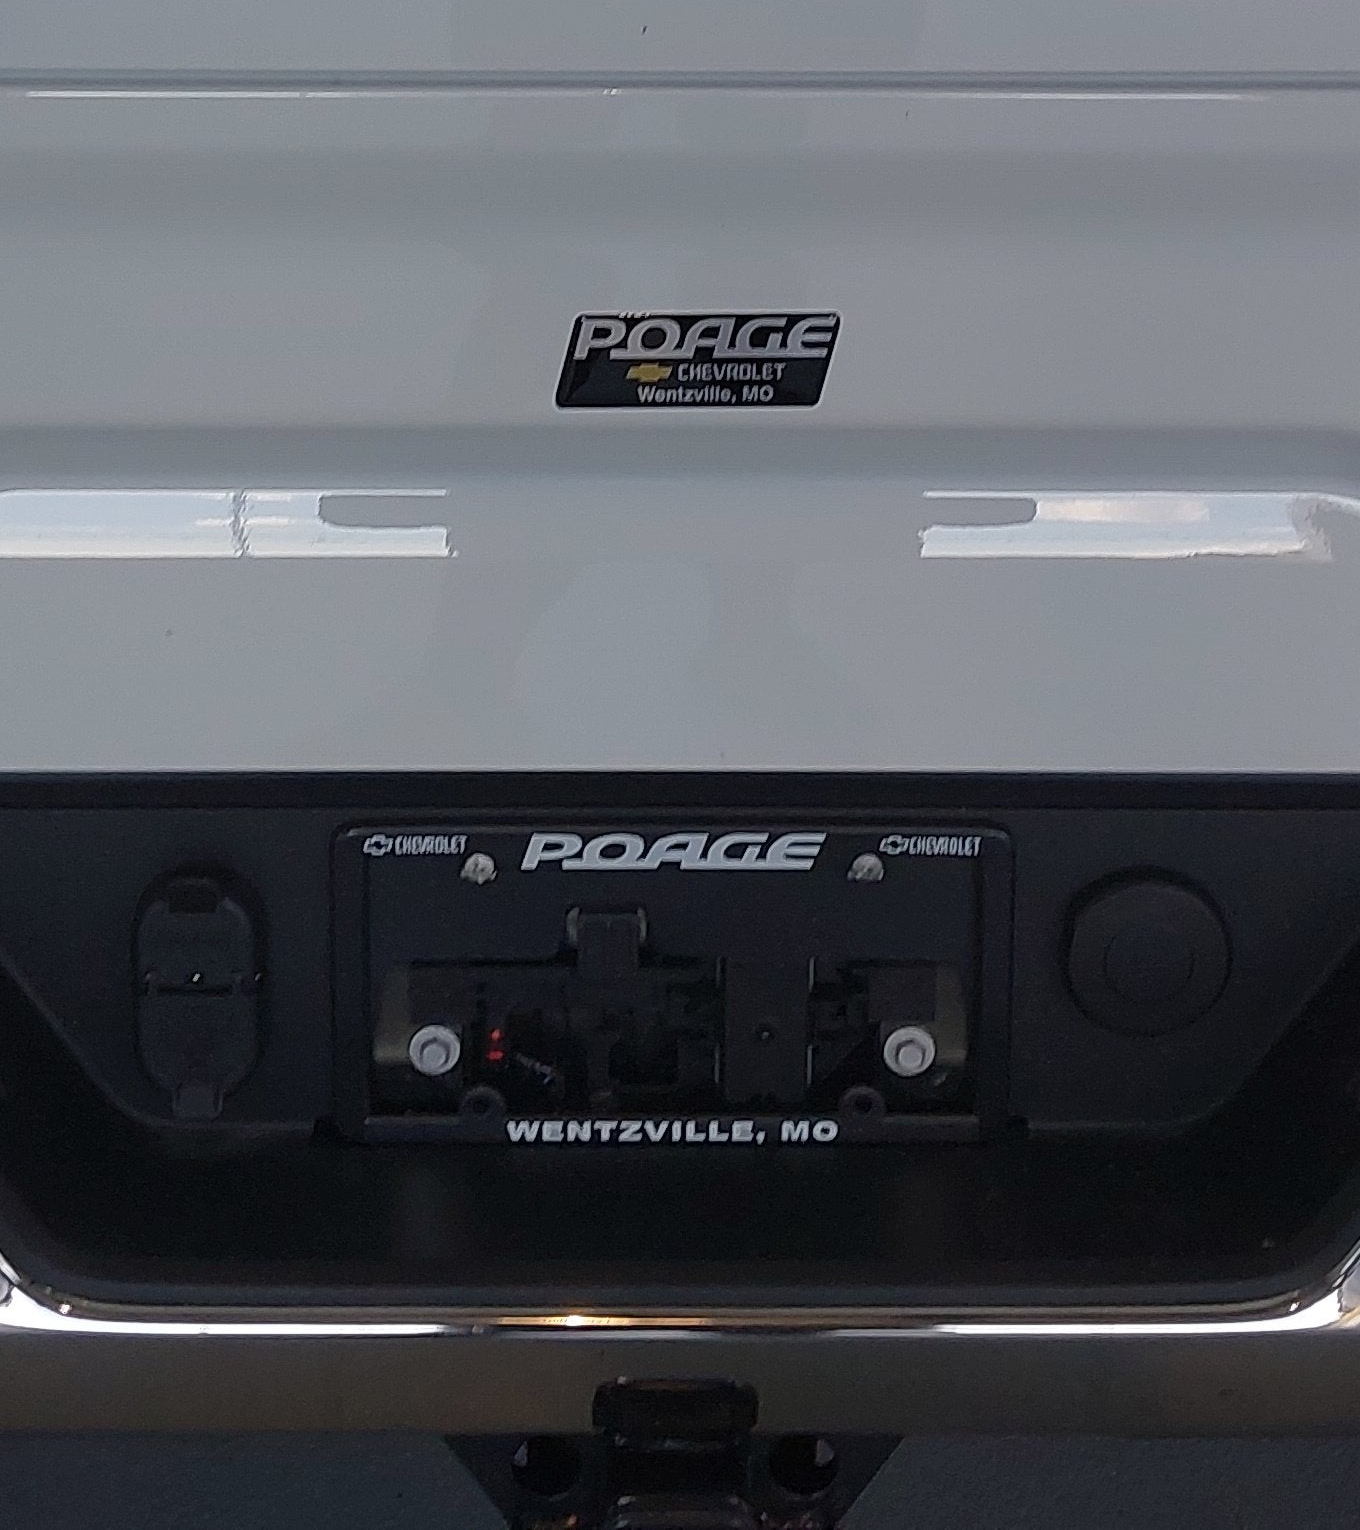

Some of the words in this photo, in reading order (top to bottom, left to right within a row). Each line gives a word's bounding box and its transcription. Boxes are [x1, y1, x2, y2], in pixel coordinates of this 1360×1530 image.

[573, 317, 835, 360] POAGE
[677, 362, 786, 382] CHEVROLET
[638, 385, 737, 403] Wentzville,
[742, 384, 774, 402] MO
[395, 835, 468, 855] CHEVROLET
[520, 832, 827, 870] POAGE
[909, 836, 982, 856] CHEVROLET
[506, 1120, 766, 1145] WENTZVILLE,
[781, 1120, 839, 1142] MO
